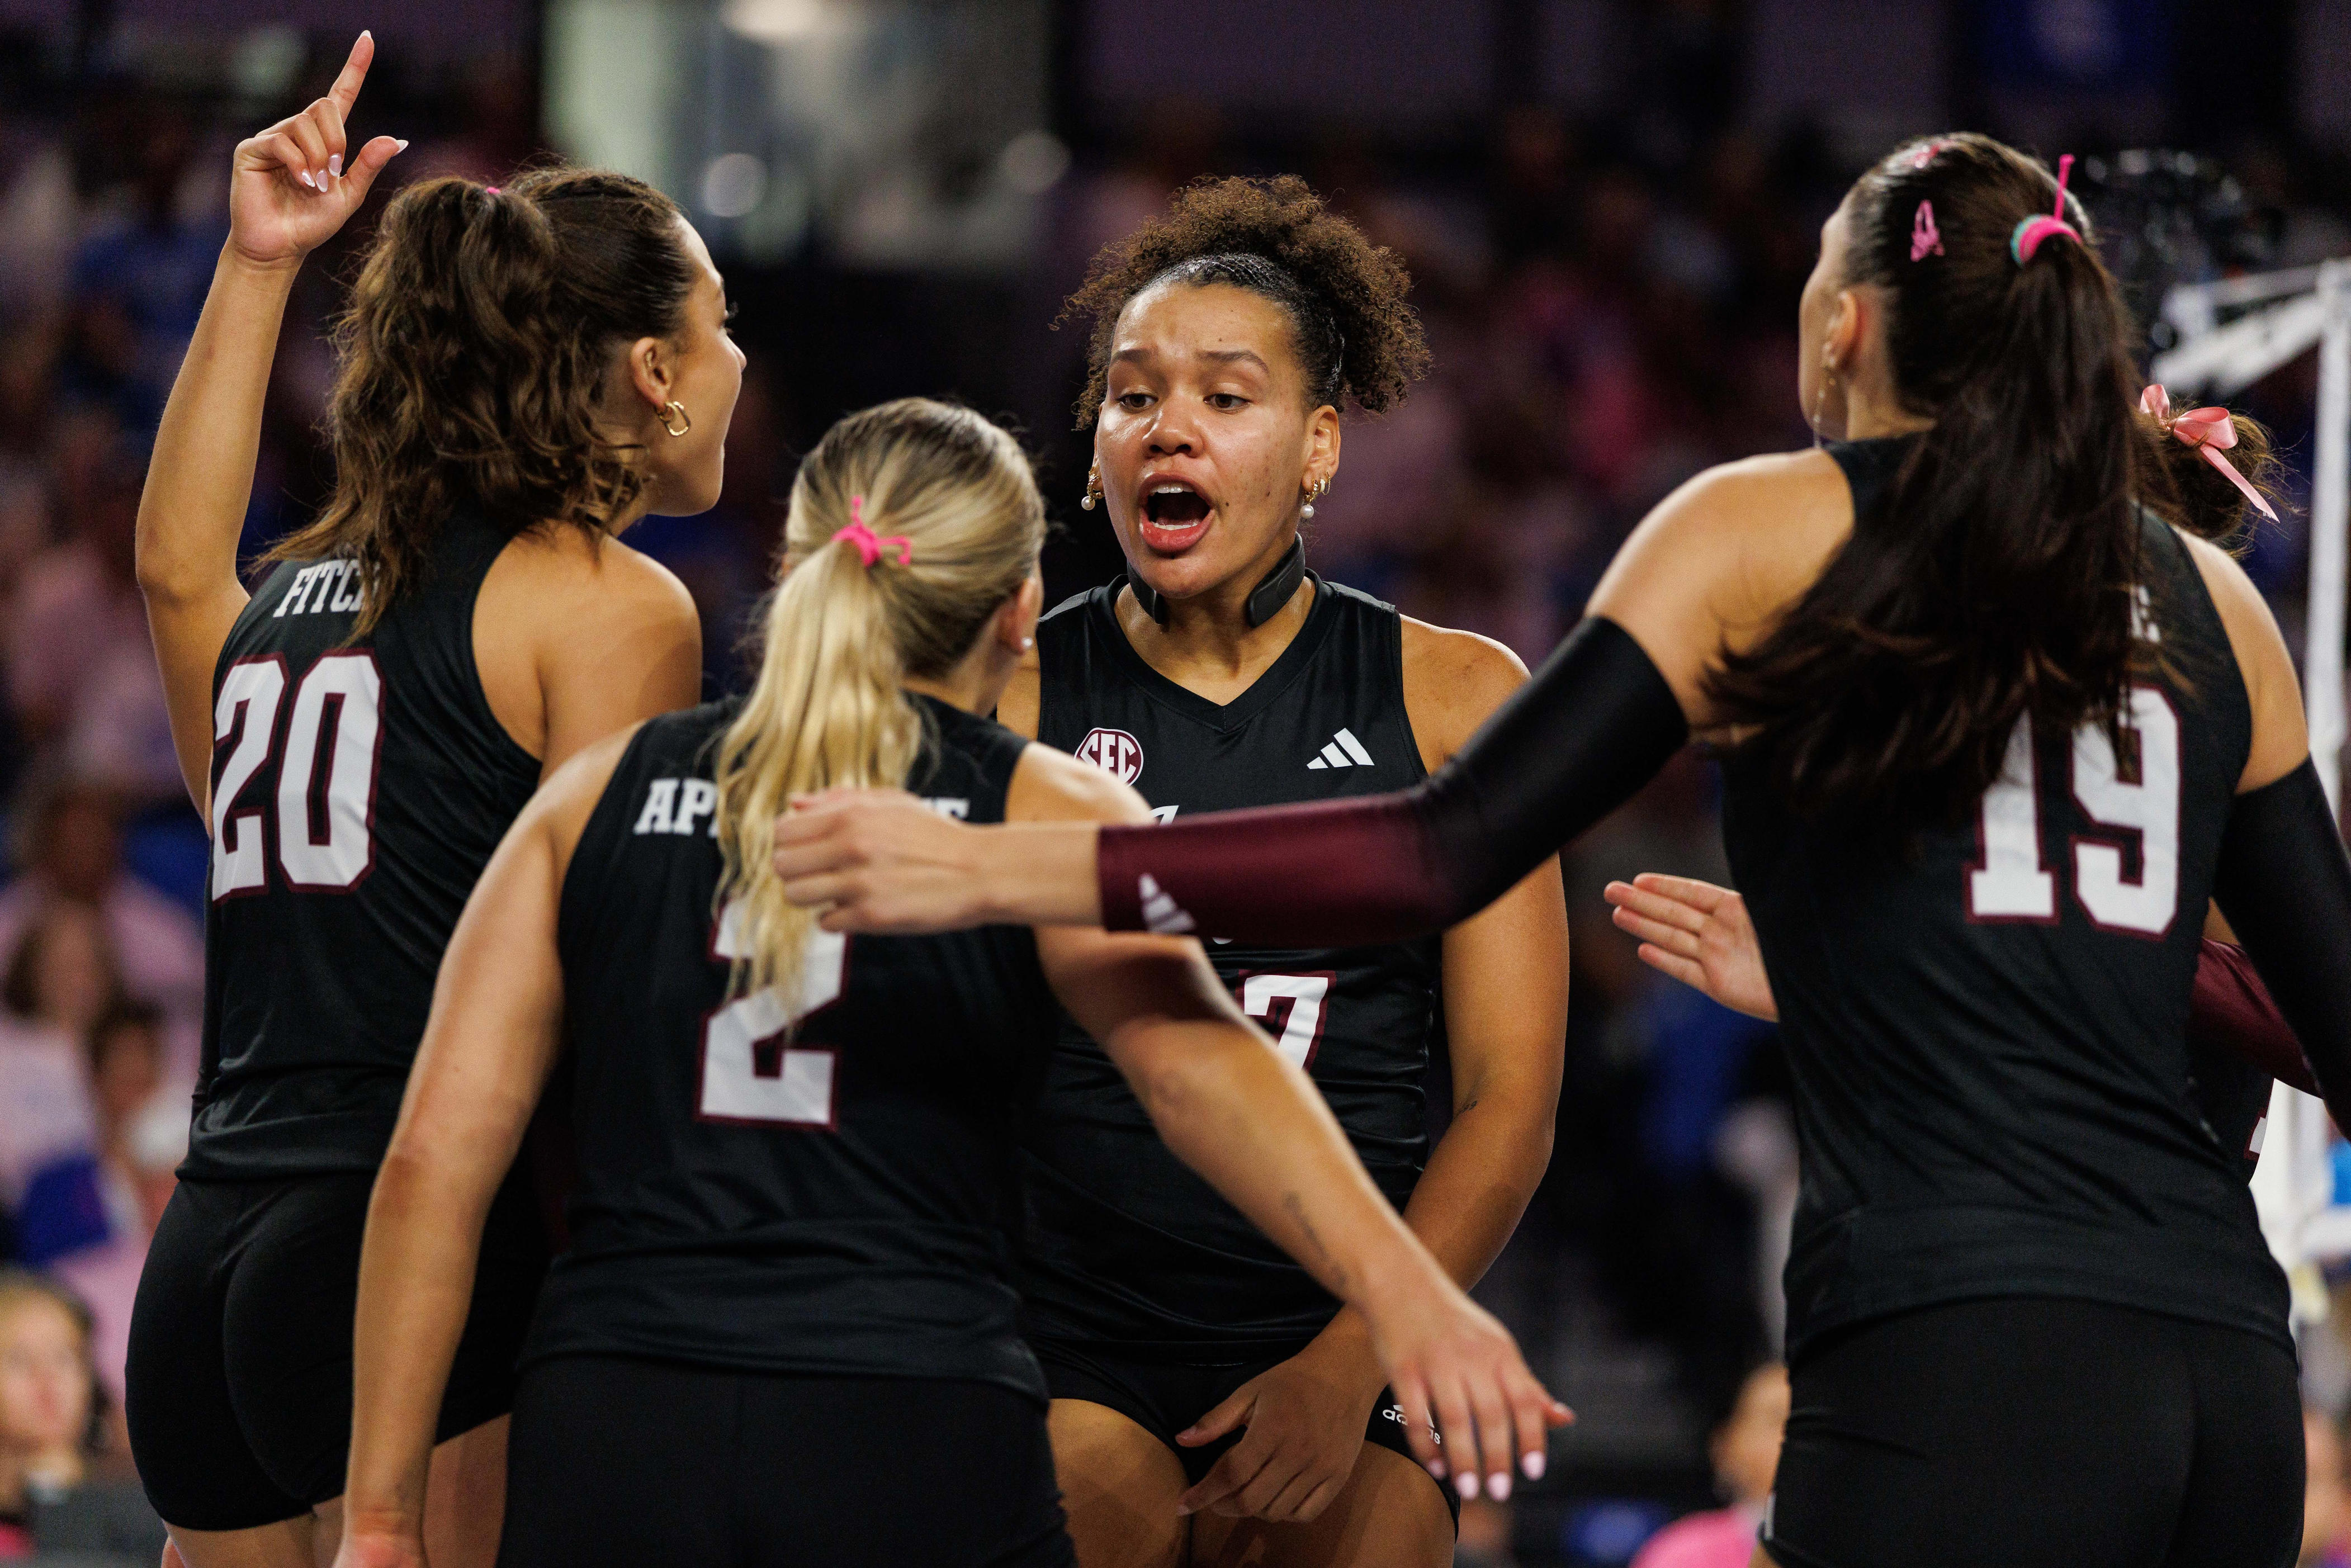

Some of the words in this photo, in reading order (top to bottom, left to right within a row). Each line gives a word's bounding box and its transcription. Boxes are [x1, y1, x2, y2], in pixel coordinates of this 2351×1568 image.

[212, 650, 385, 904] 20
[1078, 731, 1137, 784] SEC
[1968, 685, 2180, 937] 19
[697, 894, 846, 1127] 2
